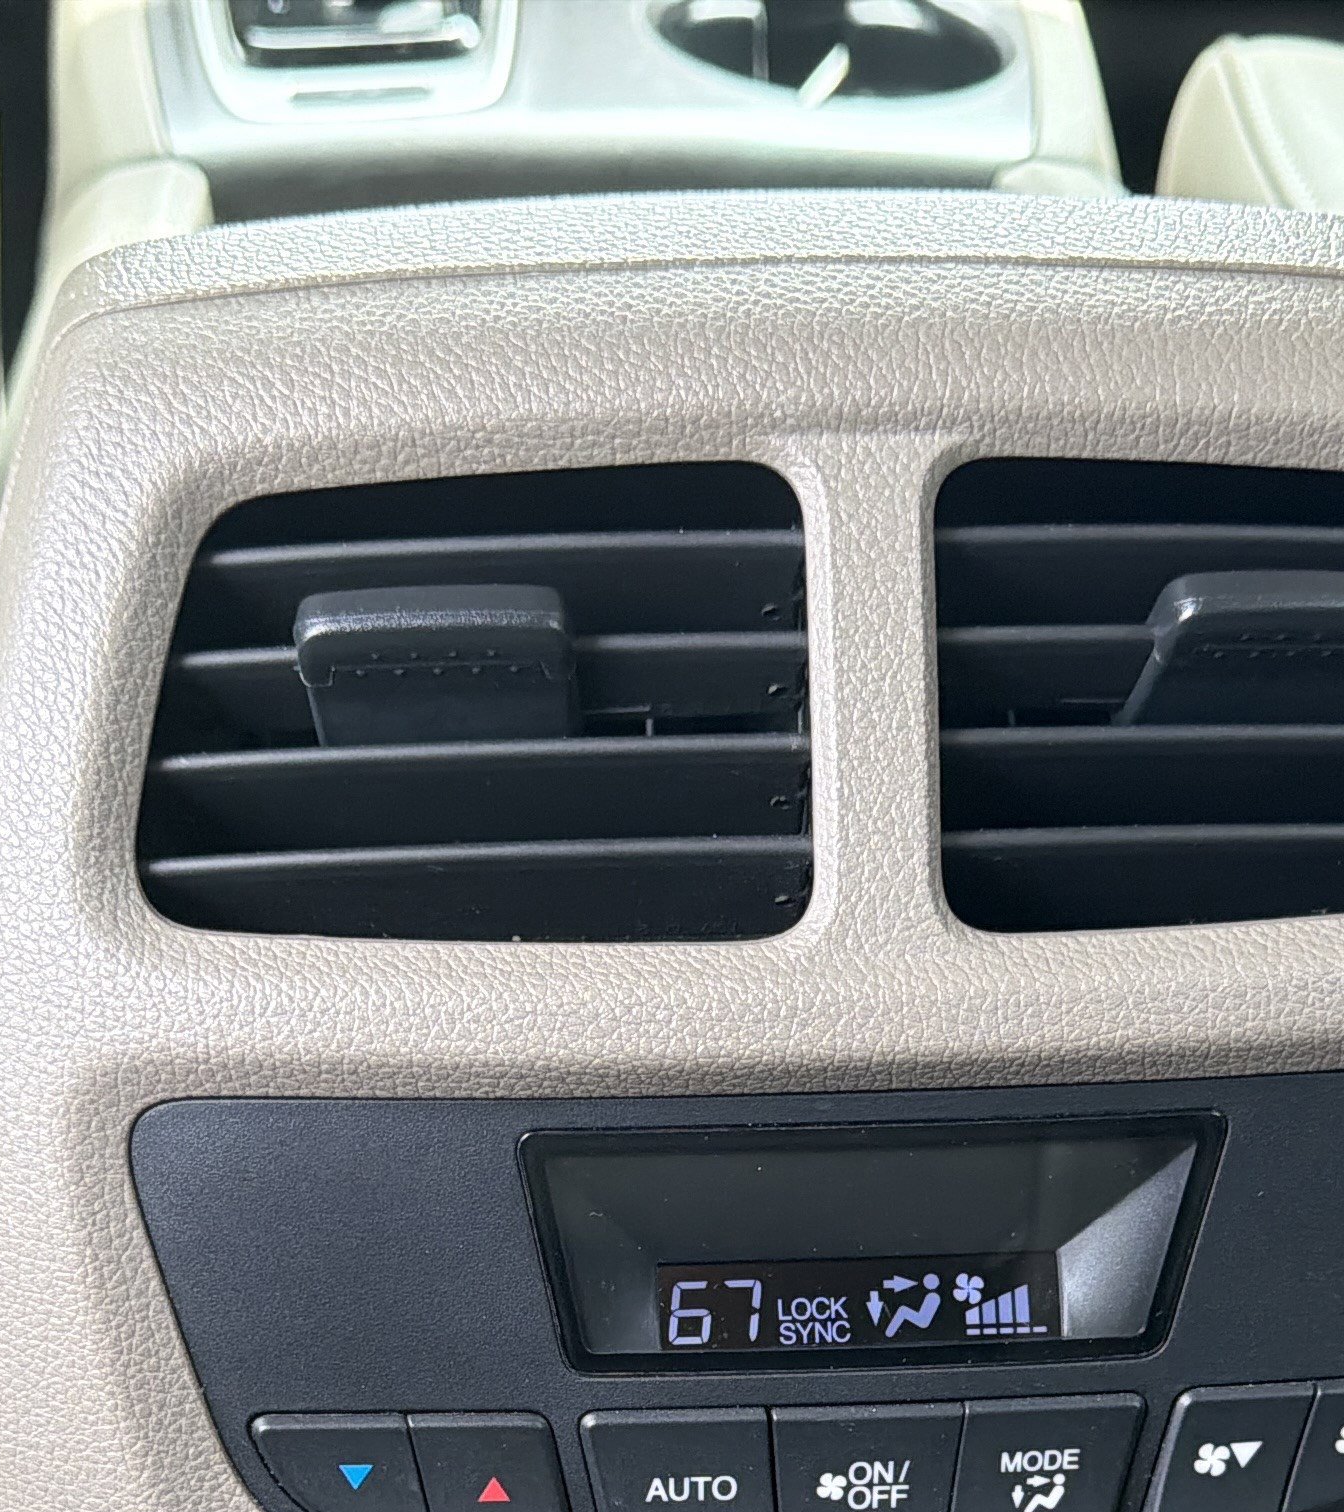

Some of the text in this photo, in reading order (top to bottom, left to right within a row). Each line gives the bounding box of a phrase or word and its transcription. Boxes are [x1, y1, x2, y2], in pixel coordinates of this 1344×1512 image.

[669, 1279, 762, 1346] 67
[777, 1296, 849, 1321] LOCK
[779, 1320, 852, 1345] SYNC
[847, 1459, 912, 1485] ON/
[1000, 1448, 1081, 1473] MODE
[645, 1475, 738, 1503] AUTO
[846, 1484, 910, 1511] OFF
